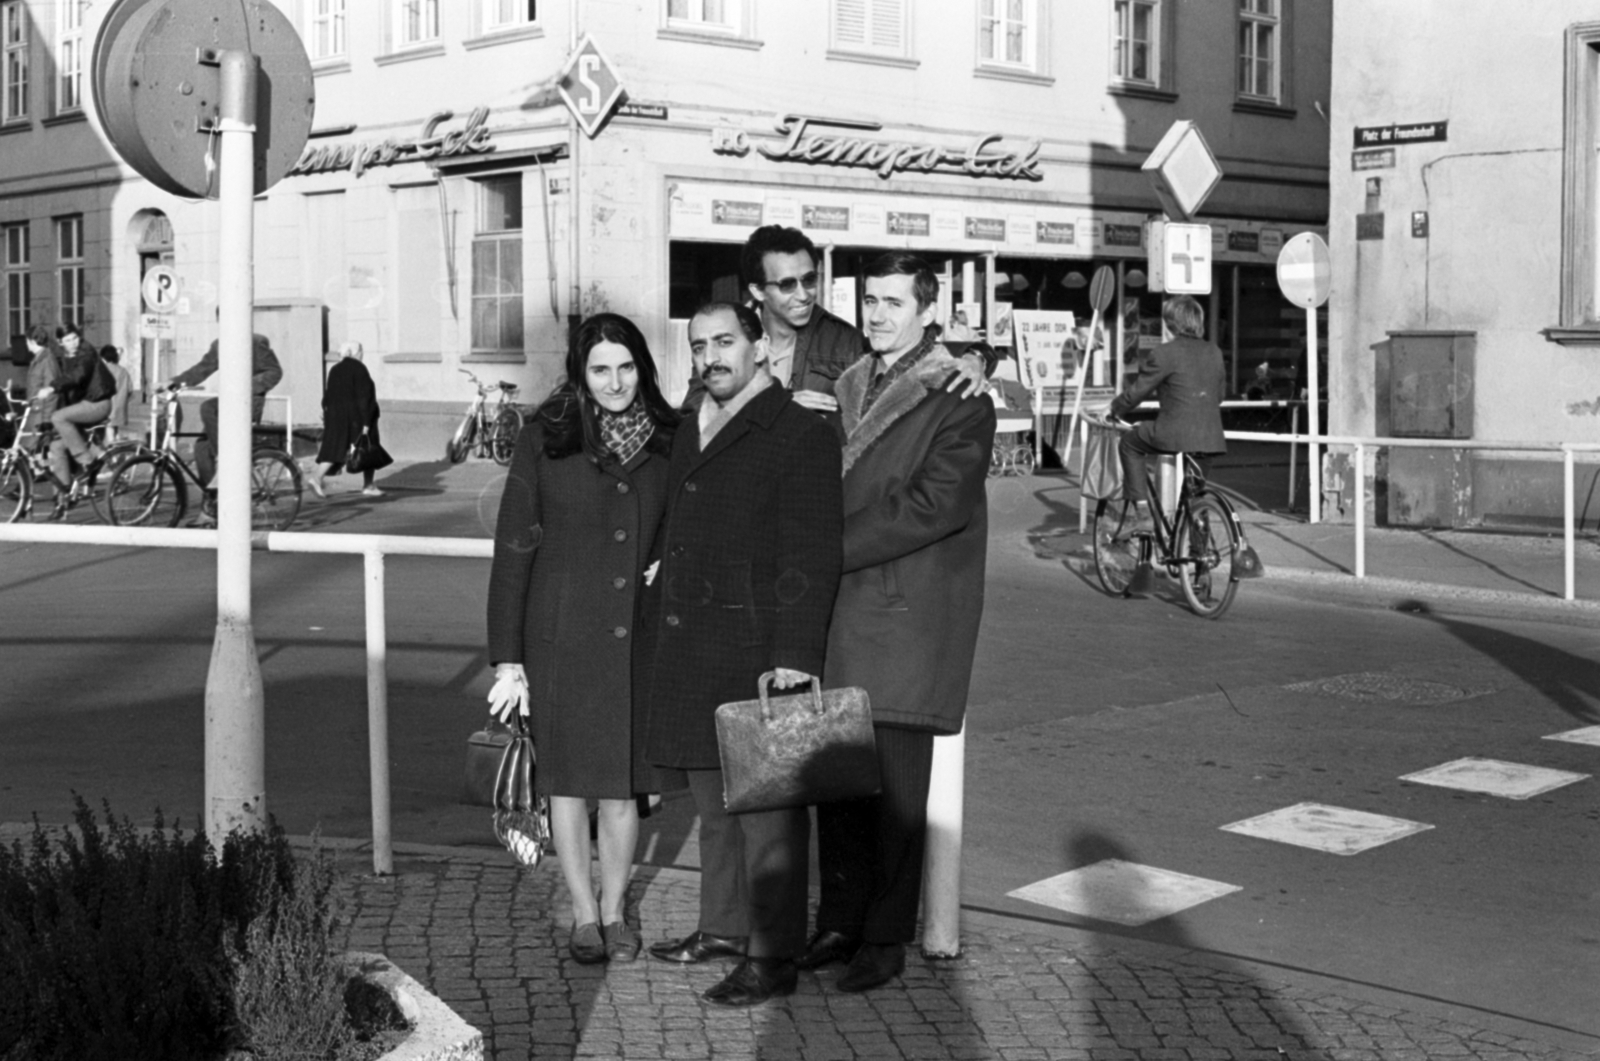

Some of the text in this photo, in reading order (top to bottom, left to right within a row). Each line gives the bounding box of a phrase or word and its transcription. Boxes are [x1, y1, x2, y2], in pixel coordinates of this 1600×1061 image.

[577, 54, 600, 115] S
[284, 106, 497, 180] empo-Eck
[711, 113, 1044, 181] HO Tempo-Eck
